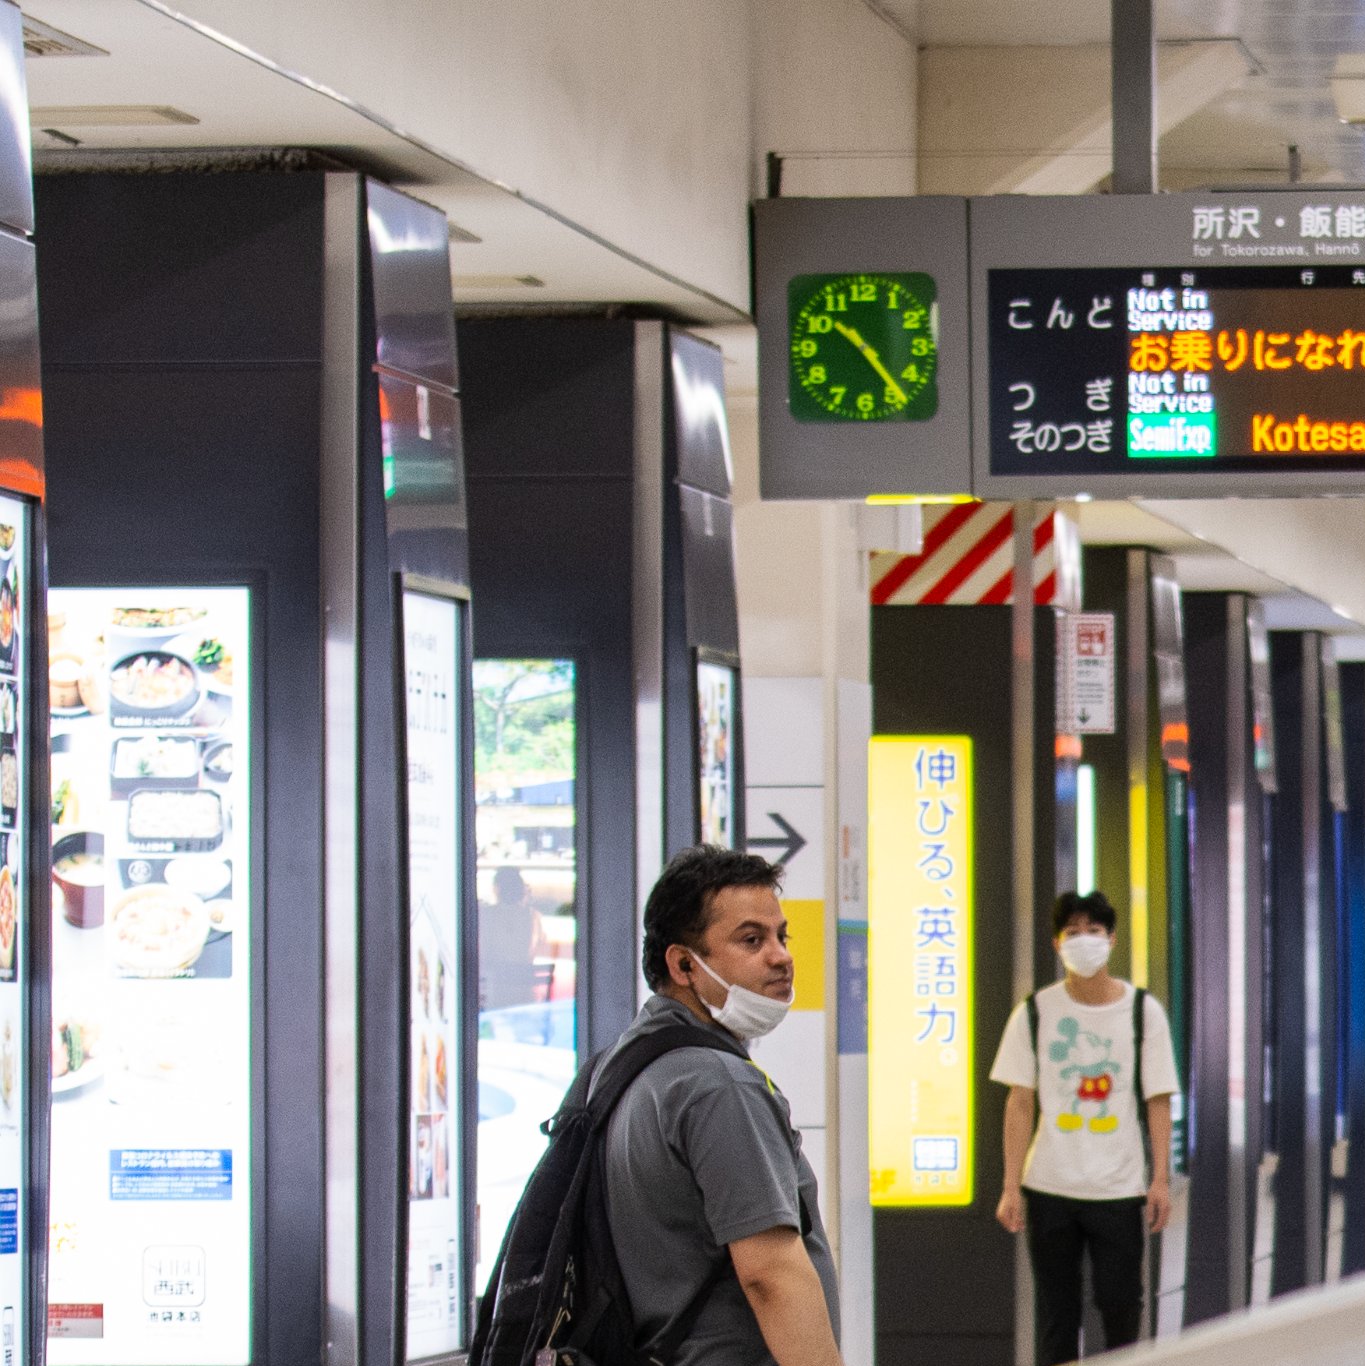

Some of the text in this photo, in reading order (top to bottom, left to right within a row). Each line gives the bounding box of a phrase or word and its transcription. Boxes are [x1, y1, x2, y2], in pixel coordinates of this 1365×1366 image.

[1193, 243, 1213, 258] for
[850, 284, 877, 301] 12
[887, 291, 898, 309] 1
[1128, 287, 1208, 312] Not in
[825, 294, 847, 311] 11
[903, 311, 920, 329] 2
[1009, 297, 1112, 329] こんど
[1127, 311, 1214, 331] Service
[808, 315, 832, 333] 10
[800, 339, 817, 358] 9
[912, 338, 928, 356] 3
[809, 366, 826, 384] 8
[902, 364, 918, 382] 4
[1128, 371, 1209, 394] Not in
[829, 386, 846, 404] 7
[856, 393, 874, 412] 6
[1128, 393, 1215, 413] Service
[1009, 420, 1113, 453] そのつぎ
